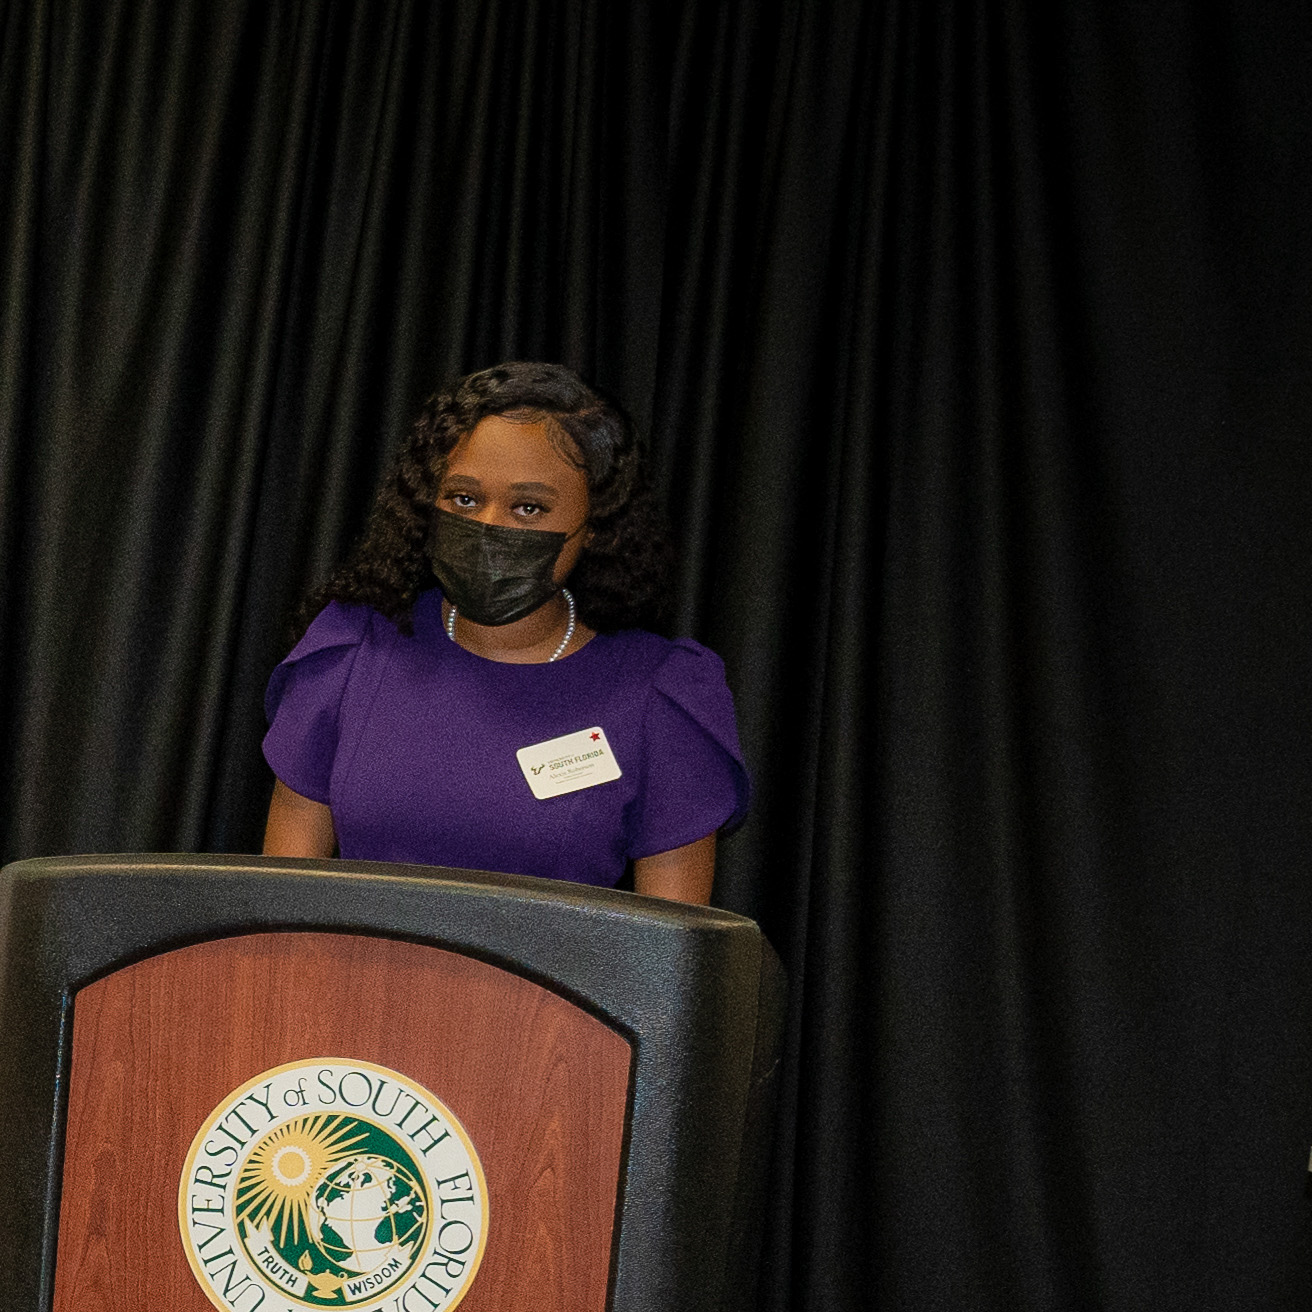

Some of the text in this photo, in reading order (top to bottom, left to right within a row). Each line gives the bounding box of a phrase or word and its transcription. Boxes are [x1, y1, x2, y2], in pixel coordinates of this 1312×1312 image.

[549, 758, 574, 771] SOUTH
[574, 748, 605, 763] FLORIDA
[283, 1077, 308, 1107] of
[317, 1069, 452, 1157] SOUTH
[257, 1246, 299, 1288] TRUTH
[347, 1257, 403, 1296] WISDOM
